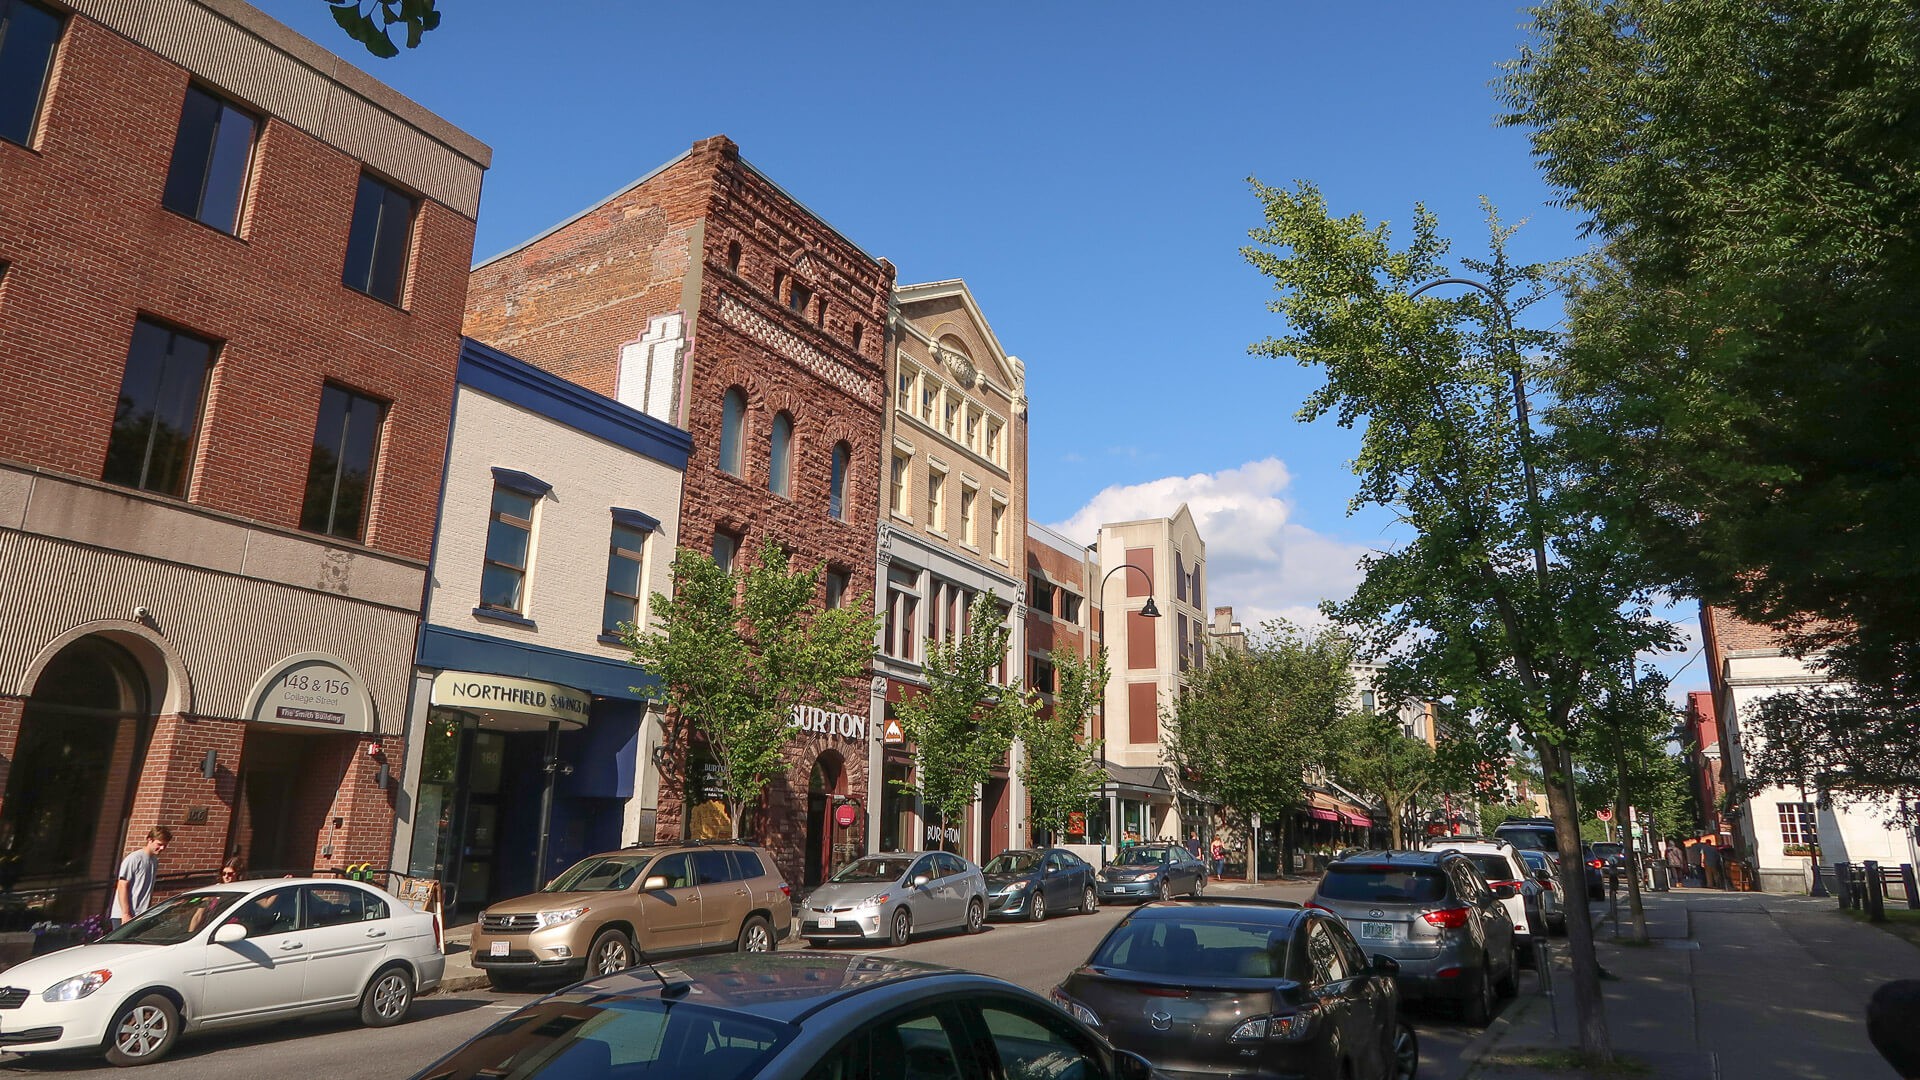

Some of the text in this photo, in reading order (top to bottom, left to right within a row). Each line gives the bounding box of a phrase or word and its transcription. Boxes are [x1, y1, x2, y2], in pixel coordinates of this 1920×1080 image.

[283, 674, 349, 696] 148 & 156
[284, 692, 338, 706] College Street
[452, 681, 546, 708] NORTHFIELD
[550, 694, 581, 713] SAVINGS
[281, 708, 341, 723] The Smith Building
